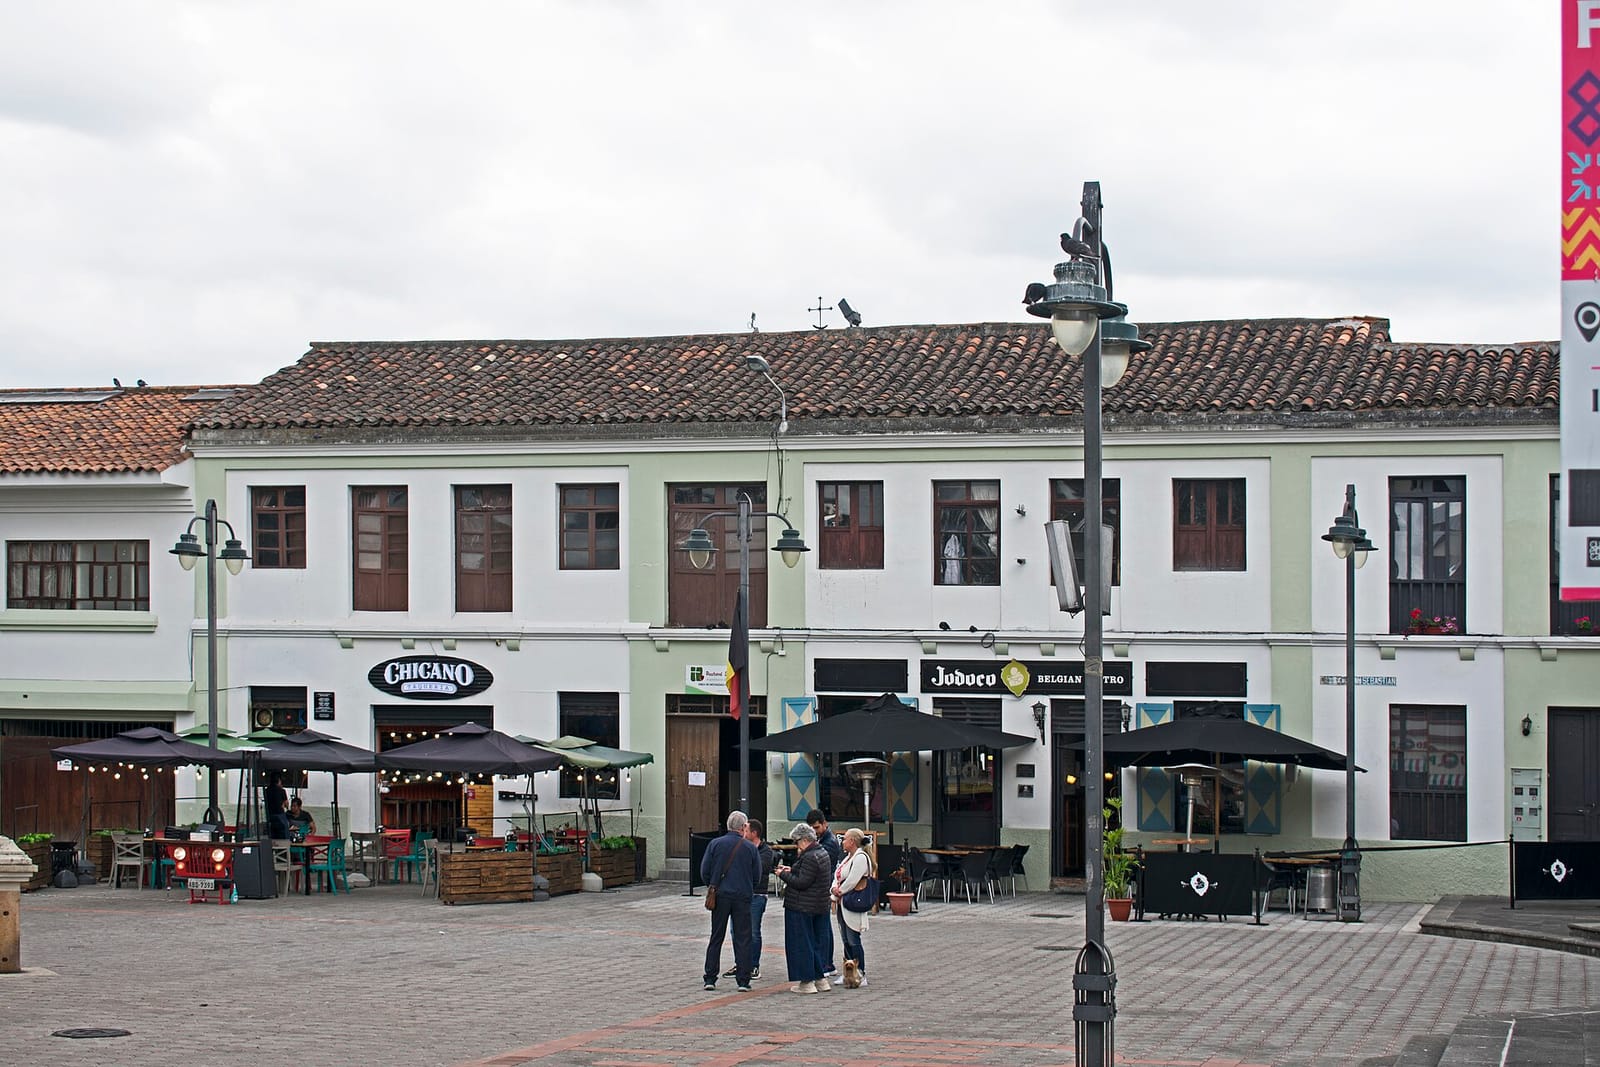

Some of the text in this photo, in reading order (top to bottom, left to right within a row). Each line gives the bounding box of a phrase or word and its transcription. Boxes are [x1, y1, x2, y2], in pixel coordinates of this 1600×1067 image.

[384, 662, 475, 686] CHICANO
[931, 666, 996, 687] Jodoco
[1038, 675, 1124, 684] BELGIAN TRO
[1361, 676, 1397, 686] SEBASTIAN
